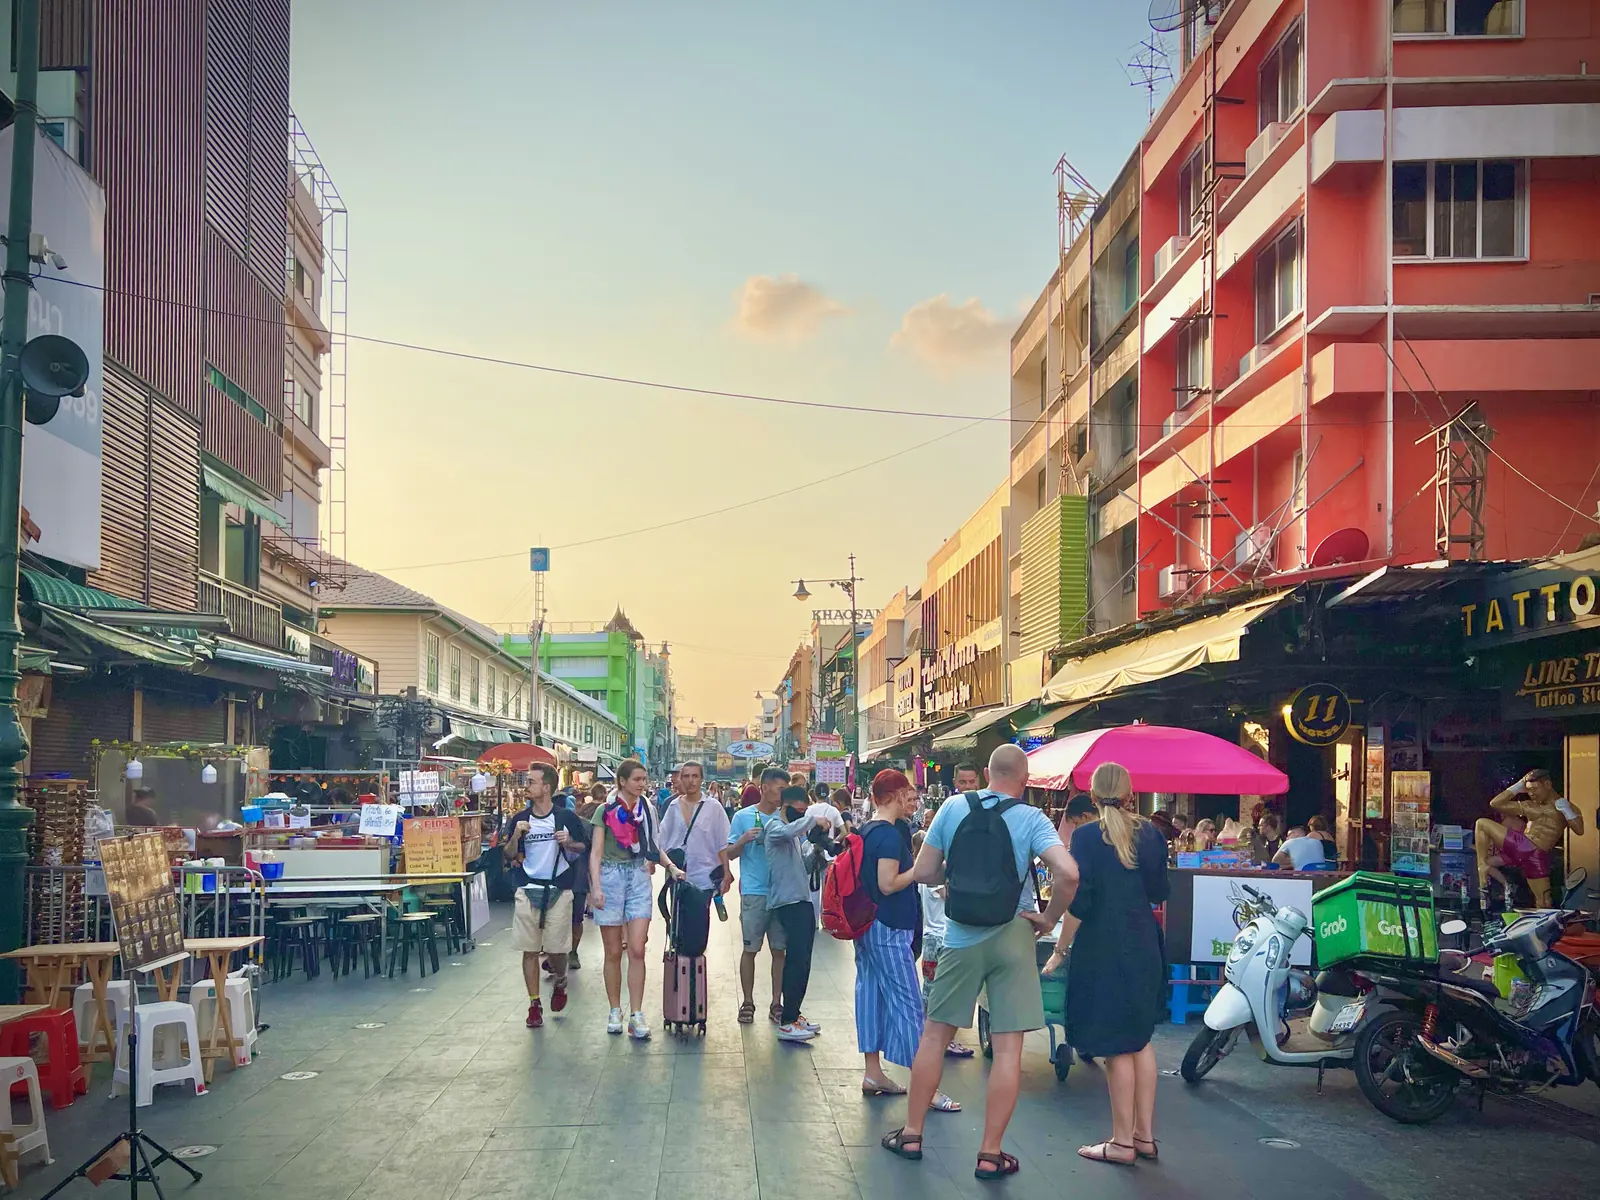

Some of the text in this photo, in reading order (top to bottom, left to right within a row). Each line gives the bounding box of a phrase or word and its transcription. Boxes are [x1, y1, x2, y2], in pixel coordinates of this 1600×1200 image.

[1523, 657, 1580, 687] LINE
[1303, 694, 1339, 722] 11
[1534, 691, 1576, 708] Tattoo
[1319, 914, 1348, 939] Grab
[1377, 919, 1419, 939] Grab
